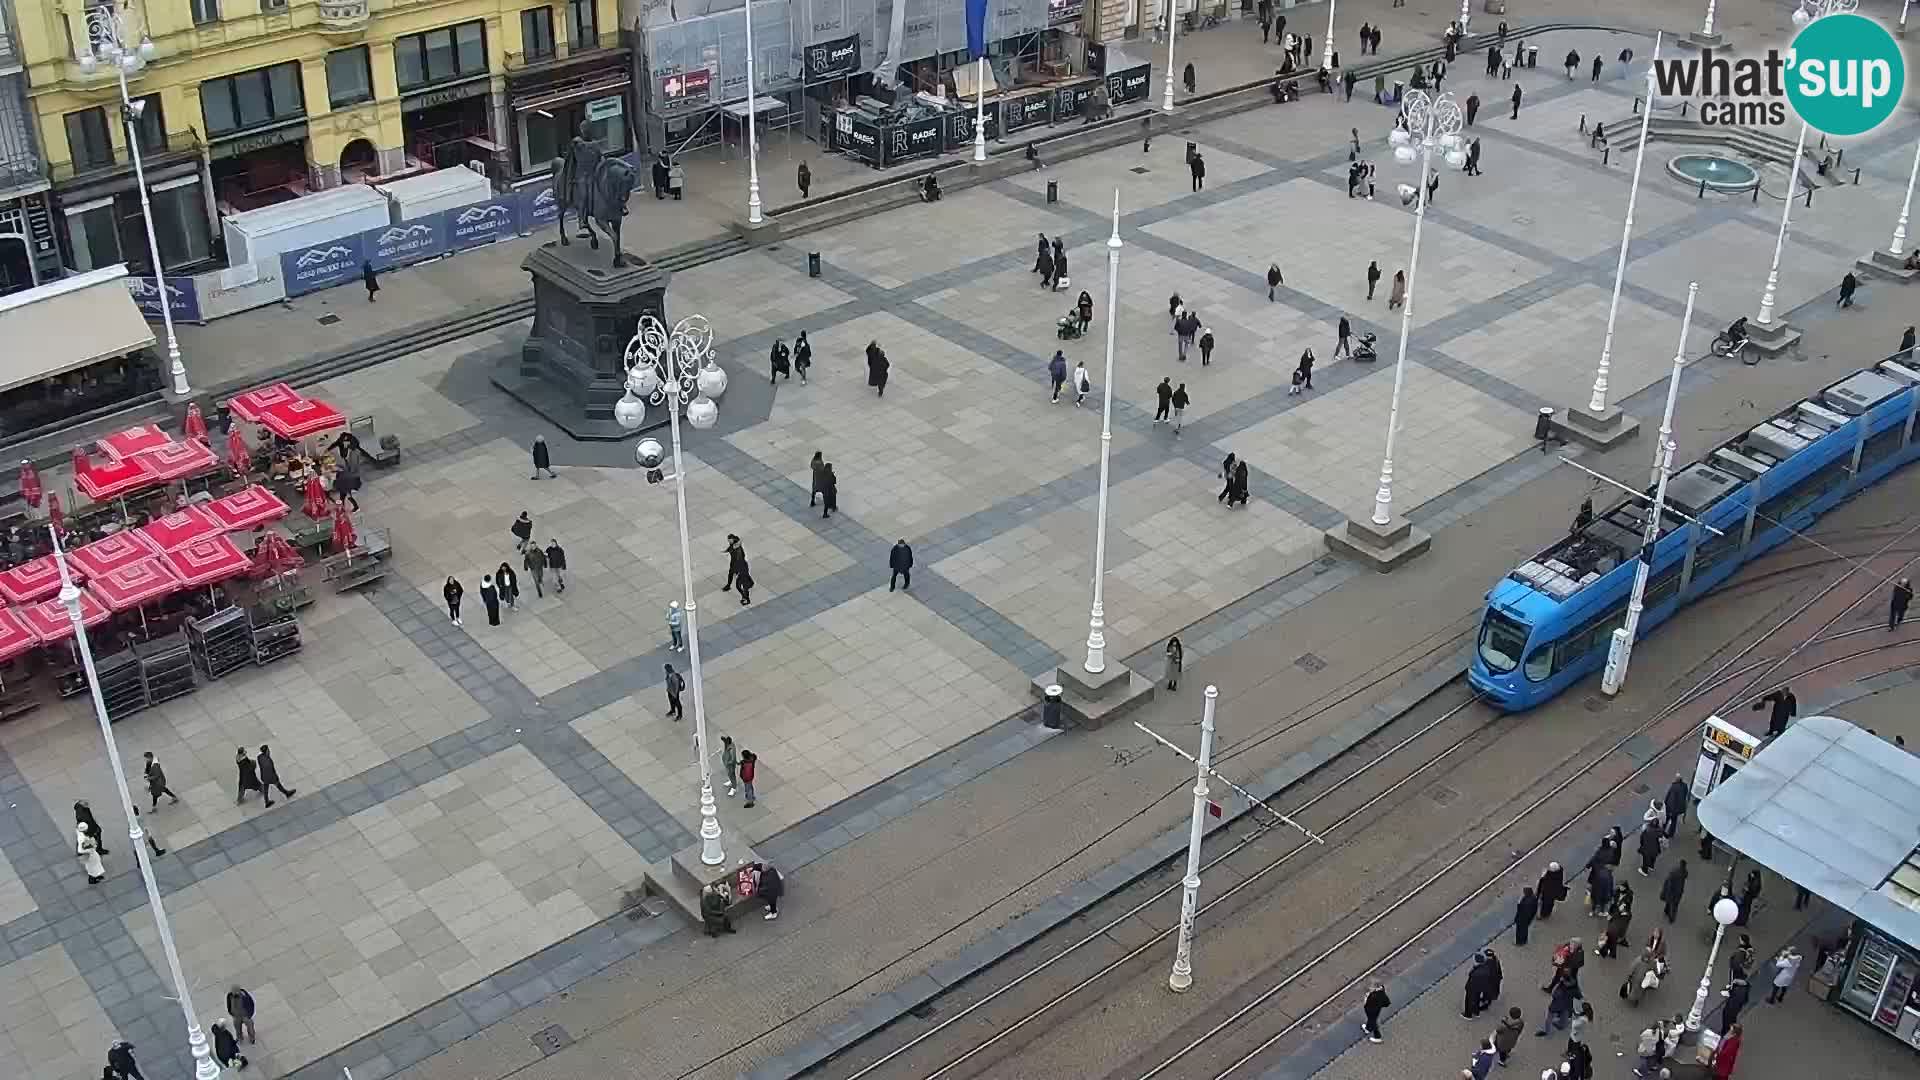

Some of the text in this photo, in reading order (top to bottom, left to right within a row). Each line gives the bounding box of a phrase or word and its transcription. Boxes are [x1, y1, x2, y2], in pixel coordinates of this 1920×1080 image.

[812, 48, 829, 73] R
[1111, 77, 1124, 99] R
[953, 115, 969, 139] R
[892, 130, 908, 154] R
